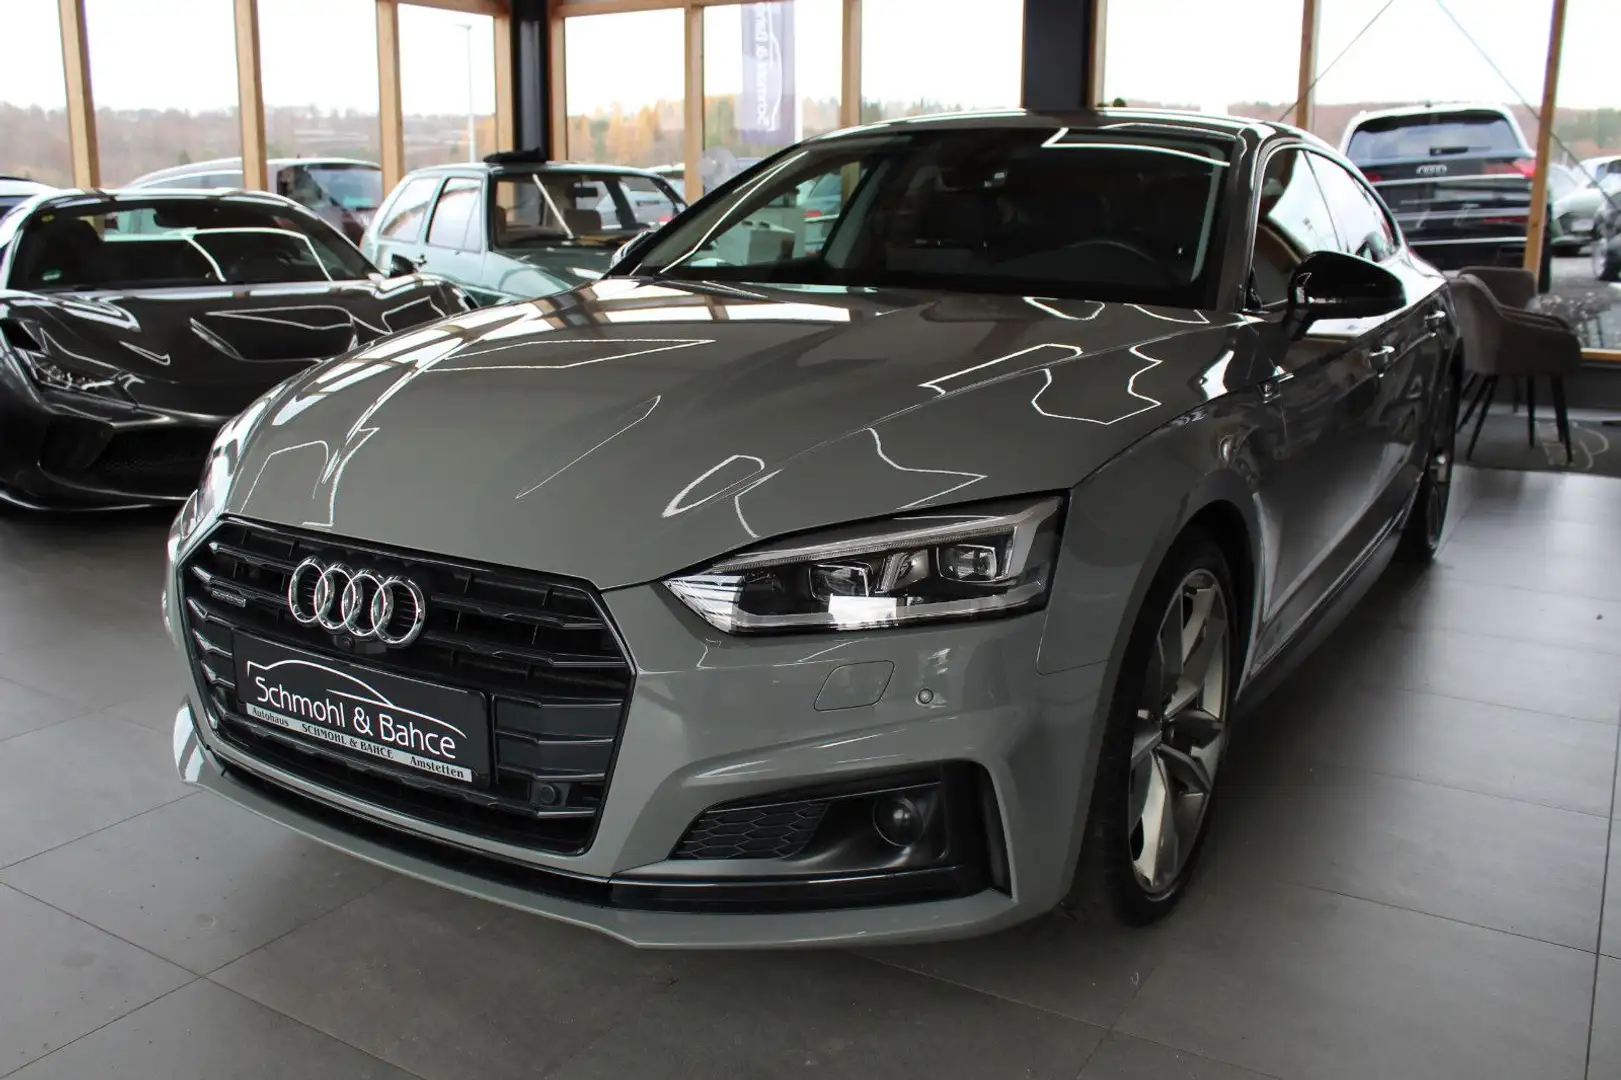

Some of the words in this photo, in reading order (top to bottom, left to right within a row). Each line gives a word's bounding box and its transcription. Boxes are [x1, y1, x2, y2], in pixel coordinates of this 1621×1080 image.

[252, 707, 289, 727] Autohaus
[301, 723, 347, 745] SCHMOHL
[349, 738, 358, 748] &
[360, 742, 394, 759] BAHCE
[410, 756, 464, 779] Amstetten
[255, 676, 346, 728] Schmohl
[353, 706, 374, 737] &
[379, 713, 456, 759] Bahce
